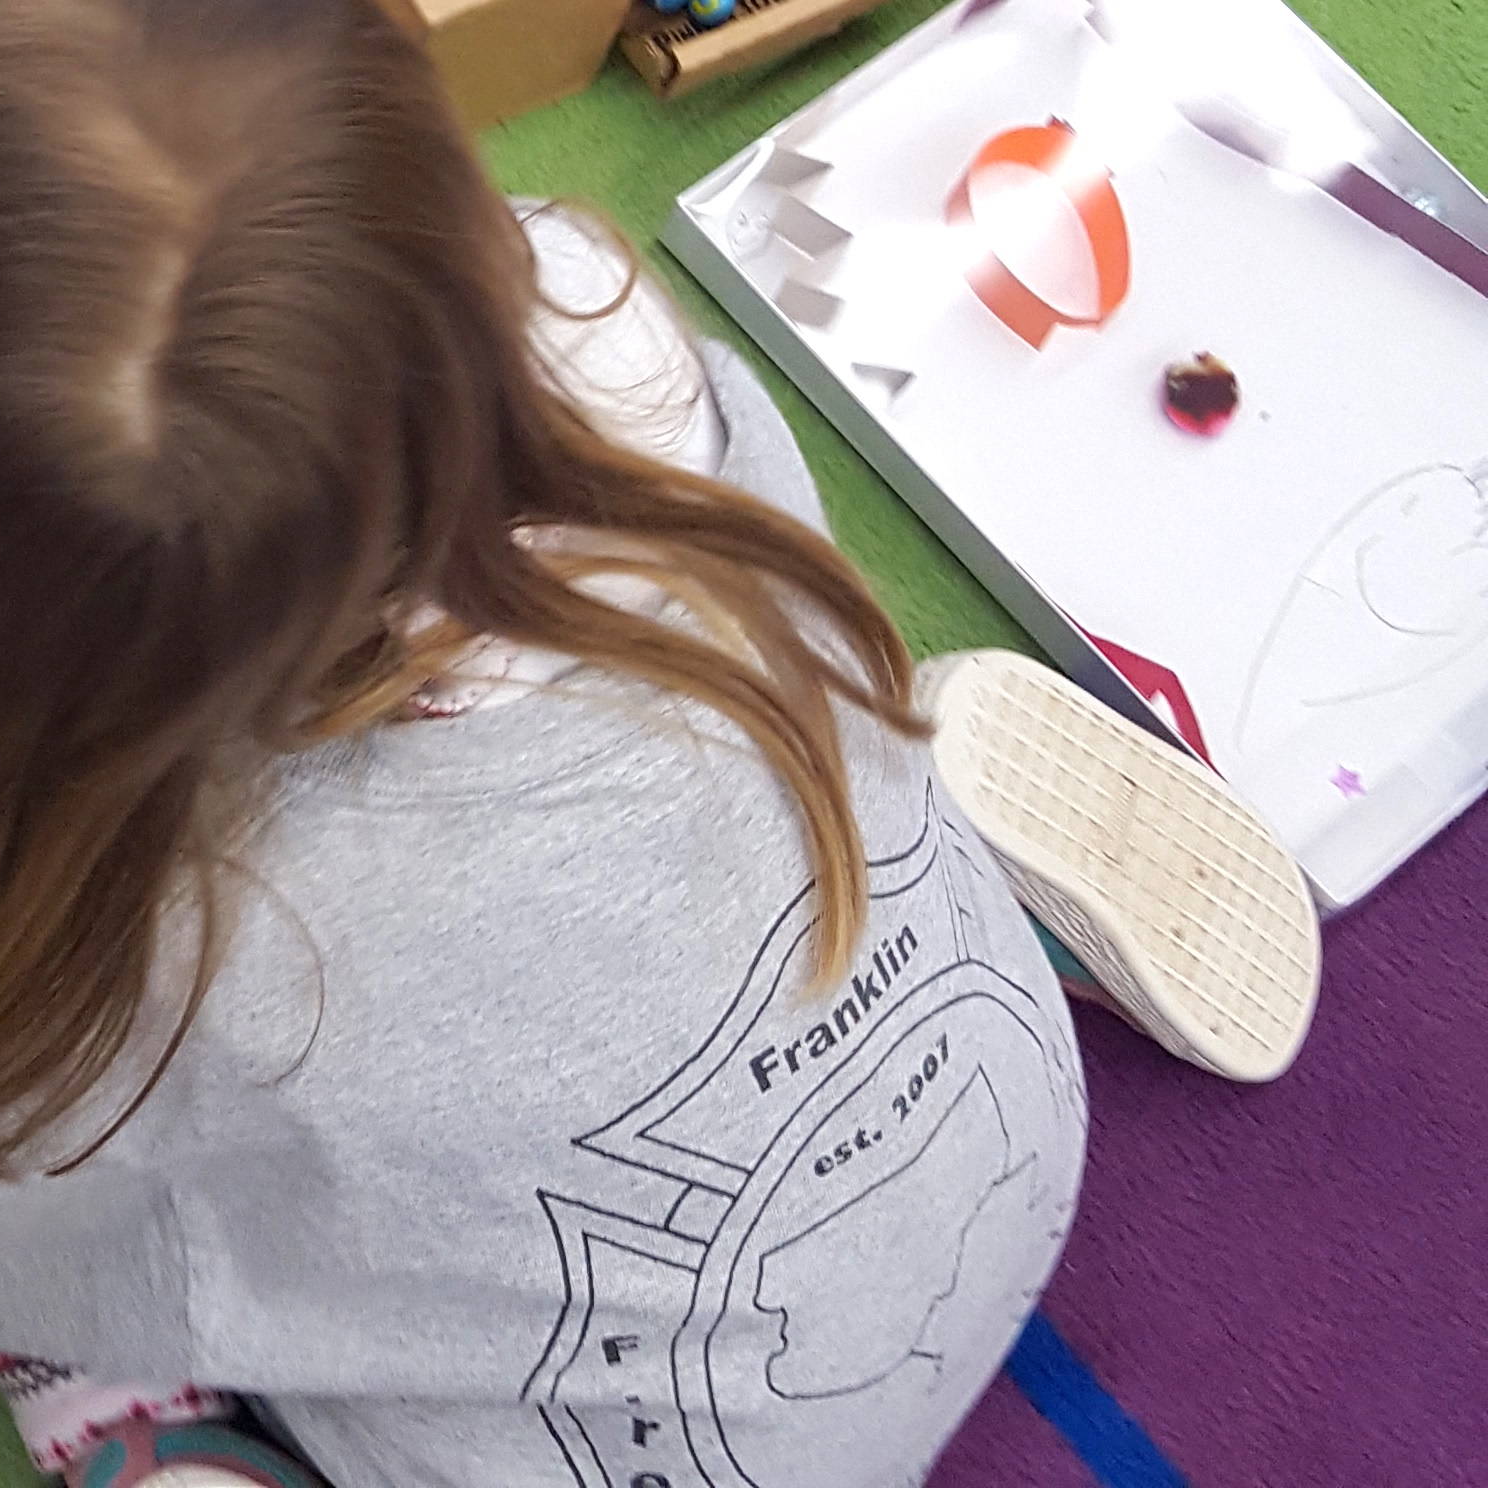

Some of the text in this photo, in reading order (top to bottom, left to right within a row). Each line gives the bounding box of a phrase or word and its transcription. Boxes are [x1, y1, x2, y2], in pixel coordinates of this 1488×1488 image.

[748, 922, 919, 1094] Franklin
[813, 1031, 950, 1178] est. 2007
